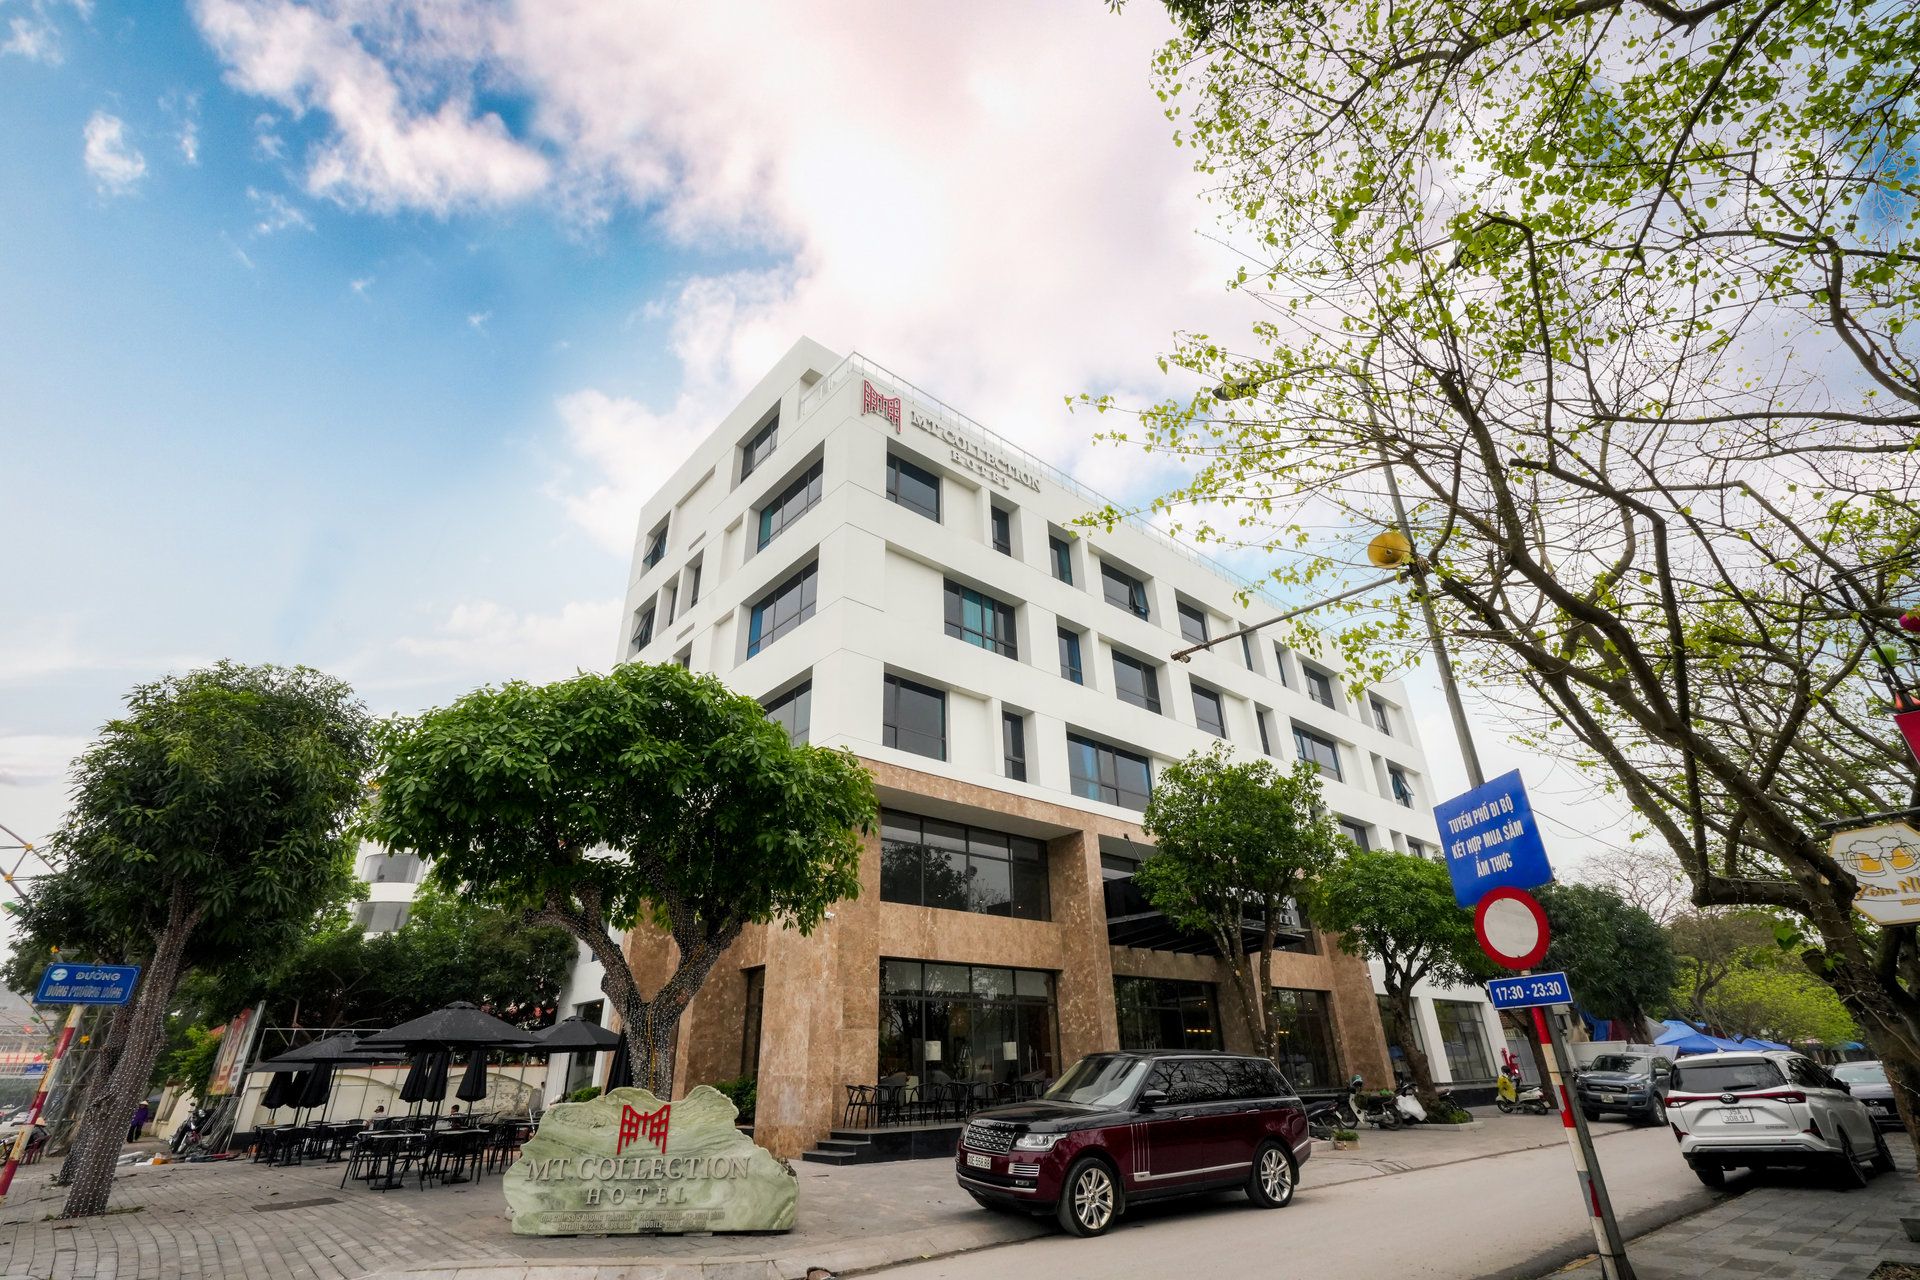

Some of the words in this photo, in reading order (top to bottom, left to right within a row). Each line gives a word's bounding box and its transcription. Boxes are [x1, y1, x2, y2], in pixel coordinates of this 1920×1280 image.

[942, 429, 1041, 494] COLLECTION
[950, 449, 1009, 491] HOTEL
[1448, 811, 1473, 834] TUYẾN
[1472, 801, 1490, 824] PHỐ
[1489, 801, 1500, 817] ĐI
[1499, 793, 1514, 813] BỘ
[1451, 839, 1466, 859] KẾT
[1466, 836, 1482, 854] HỢP
[1482, 828, 1503, 848] MUA
[1490, 852, 1513, 872] THỰC
[75, 969, 121, 981] ĐƯỜNG
[1495, 985, 1524, 1001] 17:30
[1531, 981, 1562, 998] 23:30
[525, 1158, 571, 1181] MT
[576, 1157, 750, 1181] COLLECTION
[586, 1187, 687, 1206] HOTEL
